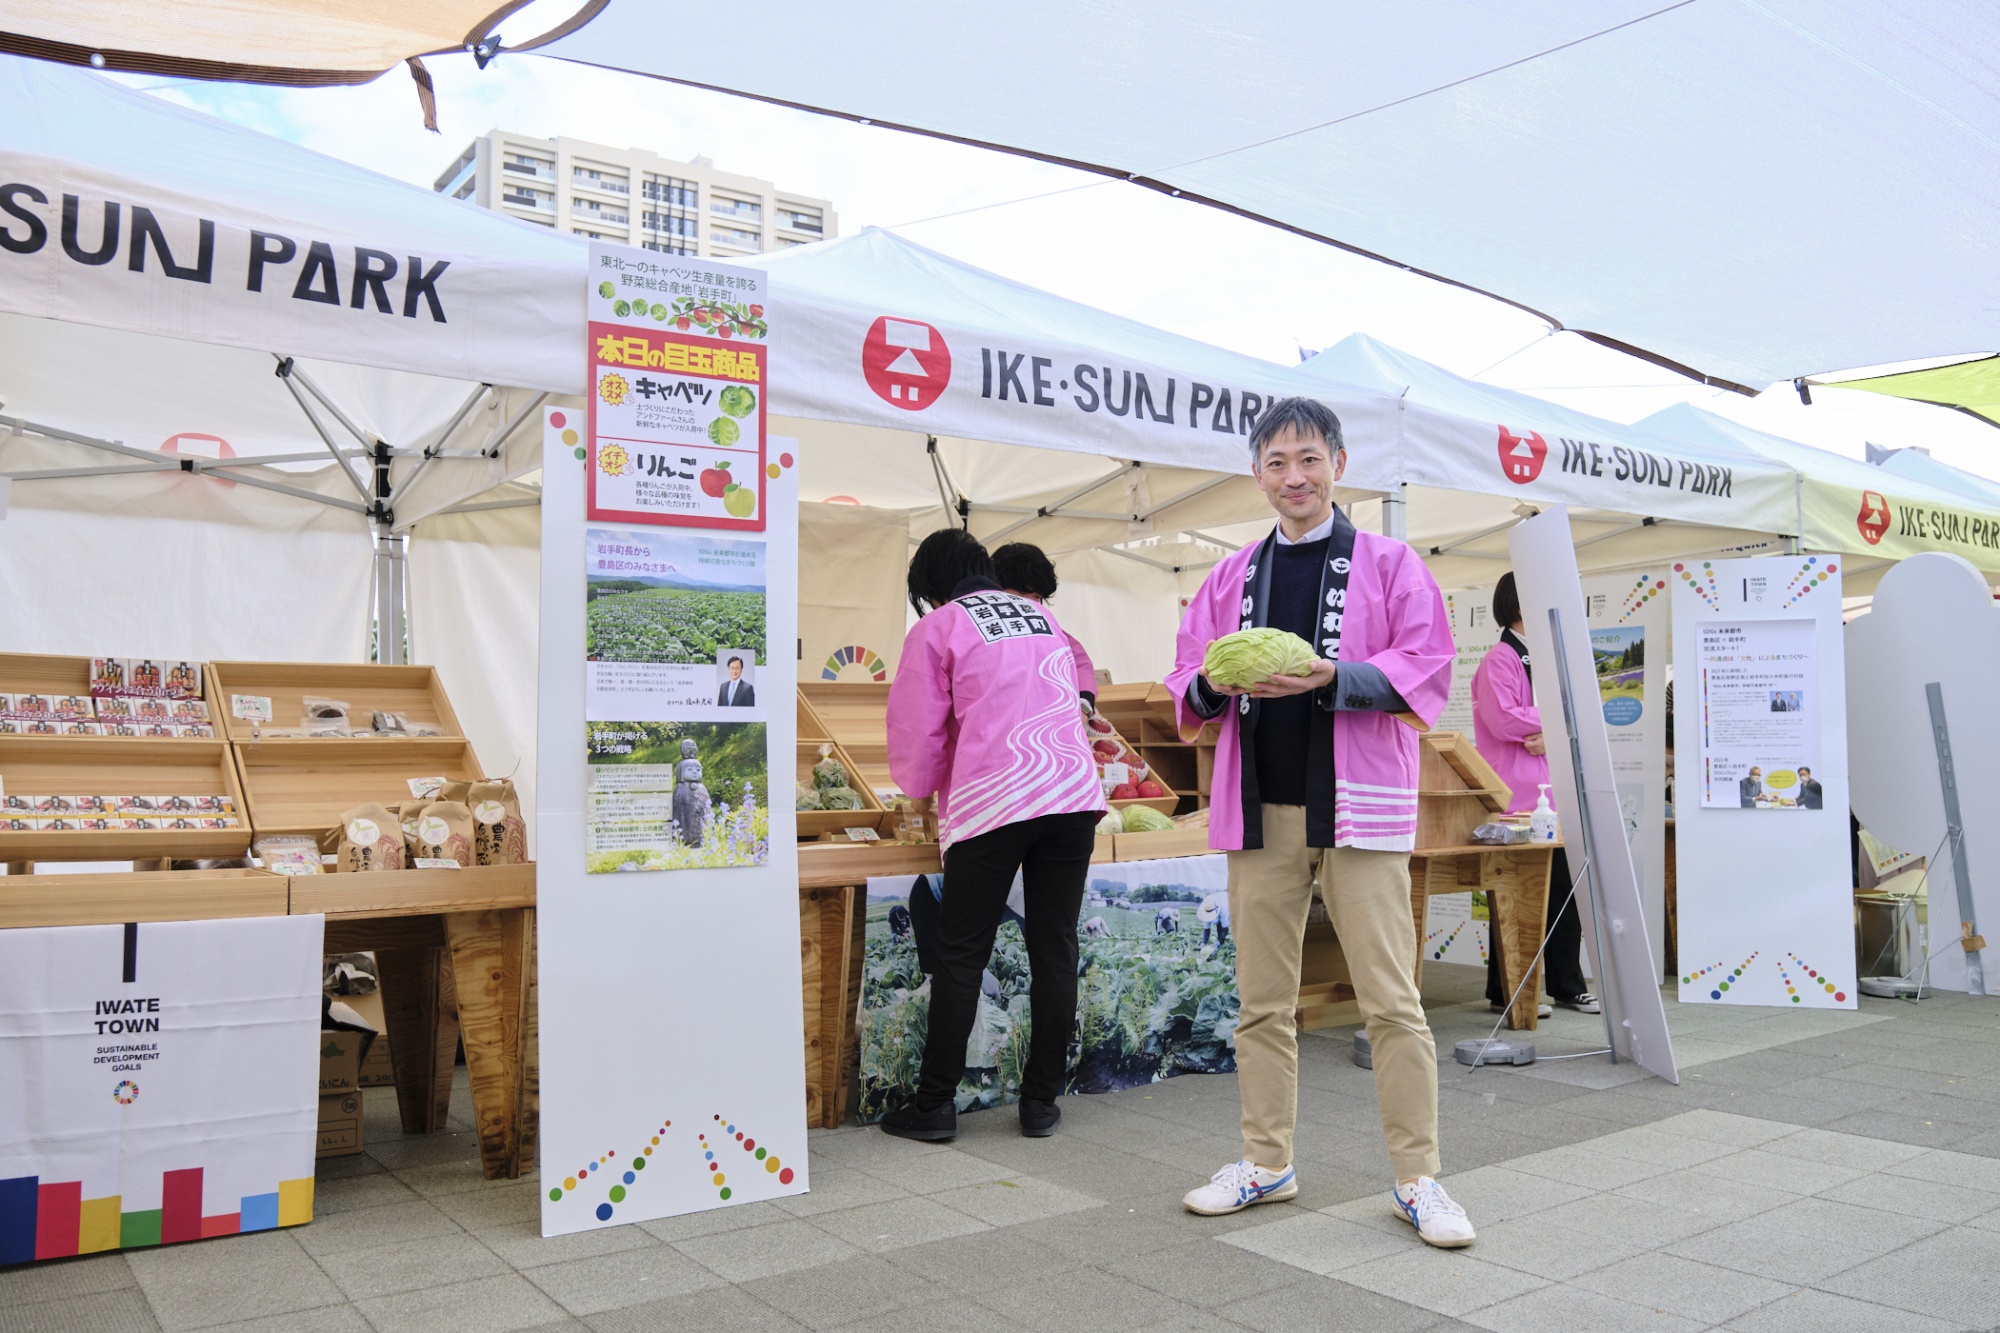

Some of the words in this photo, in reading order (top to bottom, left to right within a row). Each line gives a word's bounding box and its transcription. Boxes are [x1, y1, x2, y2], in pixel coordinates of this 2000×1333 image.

[0, 183, 215, 284] SUN
[246, 228, 451, 324] PARK
[600, 255, 757, 292] 東北一のキャベツ生産量を誇る
[621, 274, 737, 303] 野菜総合産地「岩手町」
[597, 334, 760, 382] 本日の目玉商品
[636, 377, 712, 405] キャベツ
[636, 404, 695, 416] 土づくりにこだわった
[636, 412, 696, 425] アンドファームさんの
[636, 420, 707, 434] 新鮮なキャベツが入荷中!
[637, 453, 697, 480] りんご
[1679, 460, 1733, 498] PARK
[636, 489, 693, 500] 様々な品種の味覚を
[597, 544, 651, 556] 岩手町長から
[597, 559, 677, 573] 豊島区のみなさまへ
[985, 618, 1048, 637] 岩手町
[95, 998, 160, 1016] IWATE
[94, 1017, 160, 1035] TOWN
[93, 1052, 161, 1064] DEVELOPMENT
[96, 1043, 158, 1055] SUSTAINABLE
[112, 1063, 142, 1072] GOALS
